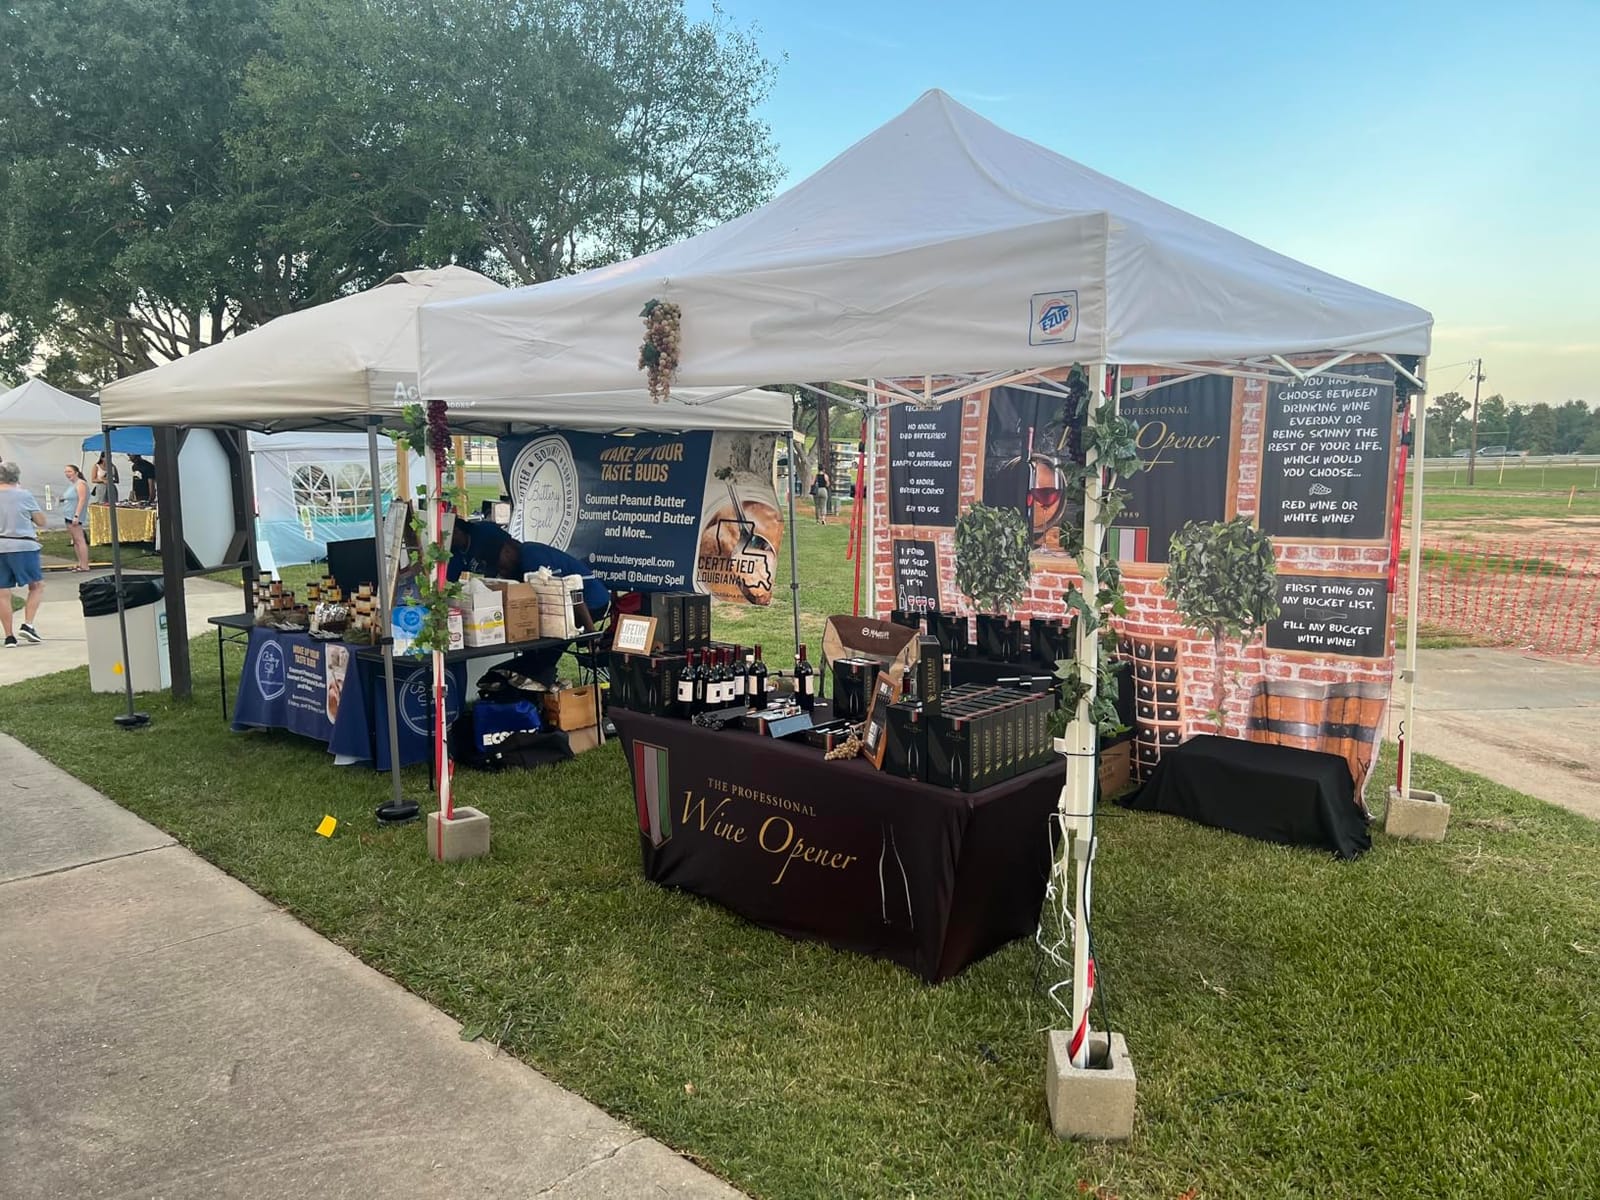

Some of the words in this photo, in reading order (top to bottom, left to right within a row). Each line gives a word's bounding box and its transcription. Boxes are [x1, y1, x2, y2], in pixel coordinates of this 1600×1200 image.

[1278, 390, 1322, 400] CHOOSE
[1326, 387, 1378, 399] BETWEEN
[1119, 405, 1190, 416] ROFESSIONAL
[1283, 402, 1337, 413] DRINKING
[1342, 401, 1371, 412] WINE
[1289, 415, 1341, 426] EVERDAY
[1345, 414, 1362, 424] OR
[1272, 429, 1304, 439] BEING
[1310, 428, 1351, 439] SKINNY
[1355, 427, 1379, 437] THE
[600, 446, 635, 462] WAKE
[650, 443, 683, 462] YOUR
[1135, 420, 1221, 473] Opener
[1268, 442, 1296, 452] REST
[1300, 442, 1316, 452] OF
[1320, 441, 1351, 452] YOUR
[1355, 441, 1383, 451] LIFE.
[1283, 455, 1320, 465] WHICH
[1323, 454, 1362, 465] WOULD
[601, 463, 633, 481] TASTE
[635, 463, 669, 482] BUDS
[1283, 468, 1305, 477] YOU
[1309, 467, 1361, 478] CHOOSE...
[585, 493, 618, 505] Gourmet
[620, 494, 652, 506] Peanut
[654, 495, 686, 508] Butter
[1282, 500, 1306, 510] RED
[1310, 500, 1337, 511] WINE
[1342, 500, 1358, 511] OR
[579, 508, 610, 521] Gourmet
[612, 509, 661, 525] Compound
[663, 511, 695, 525] Butter
[1283, 513, 1318, 523] WHITE
[1321, 513, 1355, 524] WINE?
[604, 525, 621, 537] and
[622, 526, 652, 539] More...
[596, 553, 675, 569] www.butteryspell.com
[697, 556, 755, 574] CERTIFIED
[636, 572, 663, 585] Buttery
[664, 574, 685, 586] Spell
[696, 570, 741, 586] LOUISIANA
[1285, 583, 1317, 593] FIRST
[1321, 585, 1353, 596] THING
[1357, 587, 1374, 597] ON
[1282, 596, 1299, 604] MY
[1302, 596, 1345, 607] BUCKET
[1348, 600, 1376, 610] LIST.
[1283, 620, 1305, 630] FILL
[1308, 622, 1326, 632] MY
[1329, 623, 1373, 635] BUCKET
[1297, 634, 1323, 644] WITH
[1326, 637, 1356, 647] WINE!
[707, 777, 729, 792] THE
[731, 784, 817, 817] PROFESSIONAL
[681, 791, 748, 844] Wine
[758, 815, 857, 885] Opener
